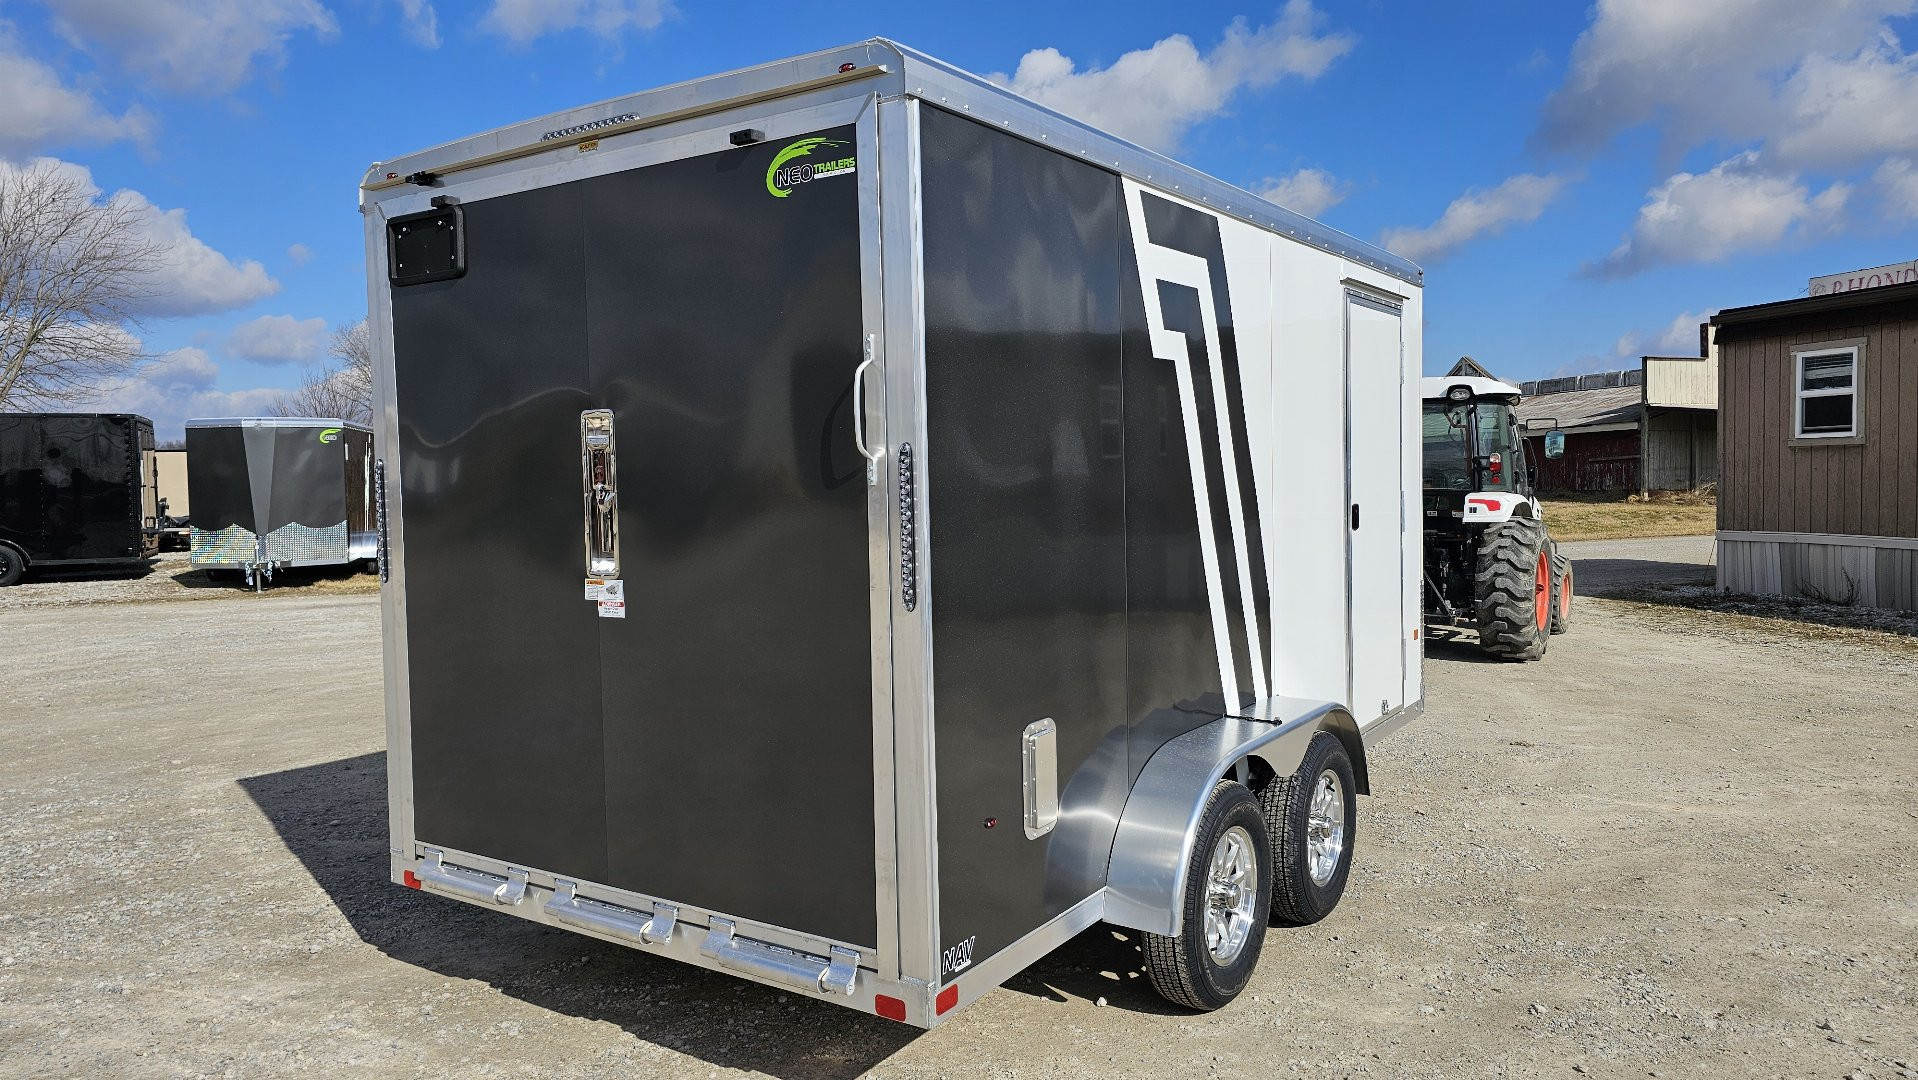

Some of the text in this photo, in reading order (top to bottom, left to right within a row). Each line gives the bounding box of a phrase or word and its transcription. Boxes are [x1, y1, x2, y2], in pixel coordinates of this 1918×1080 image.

[776, 163, 814, 188] NEO
[813, 157, 856, 174] TRAILERS
[942, 935, 976, 975] NAV
